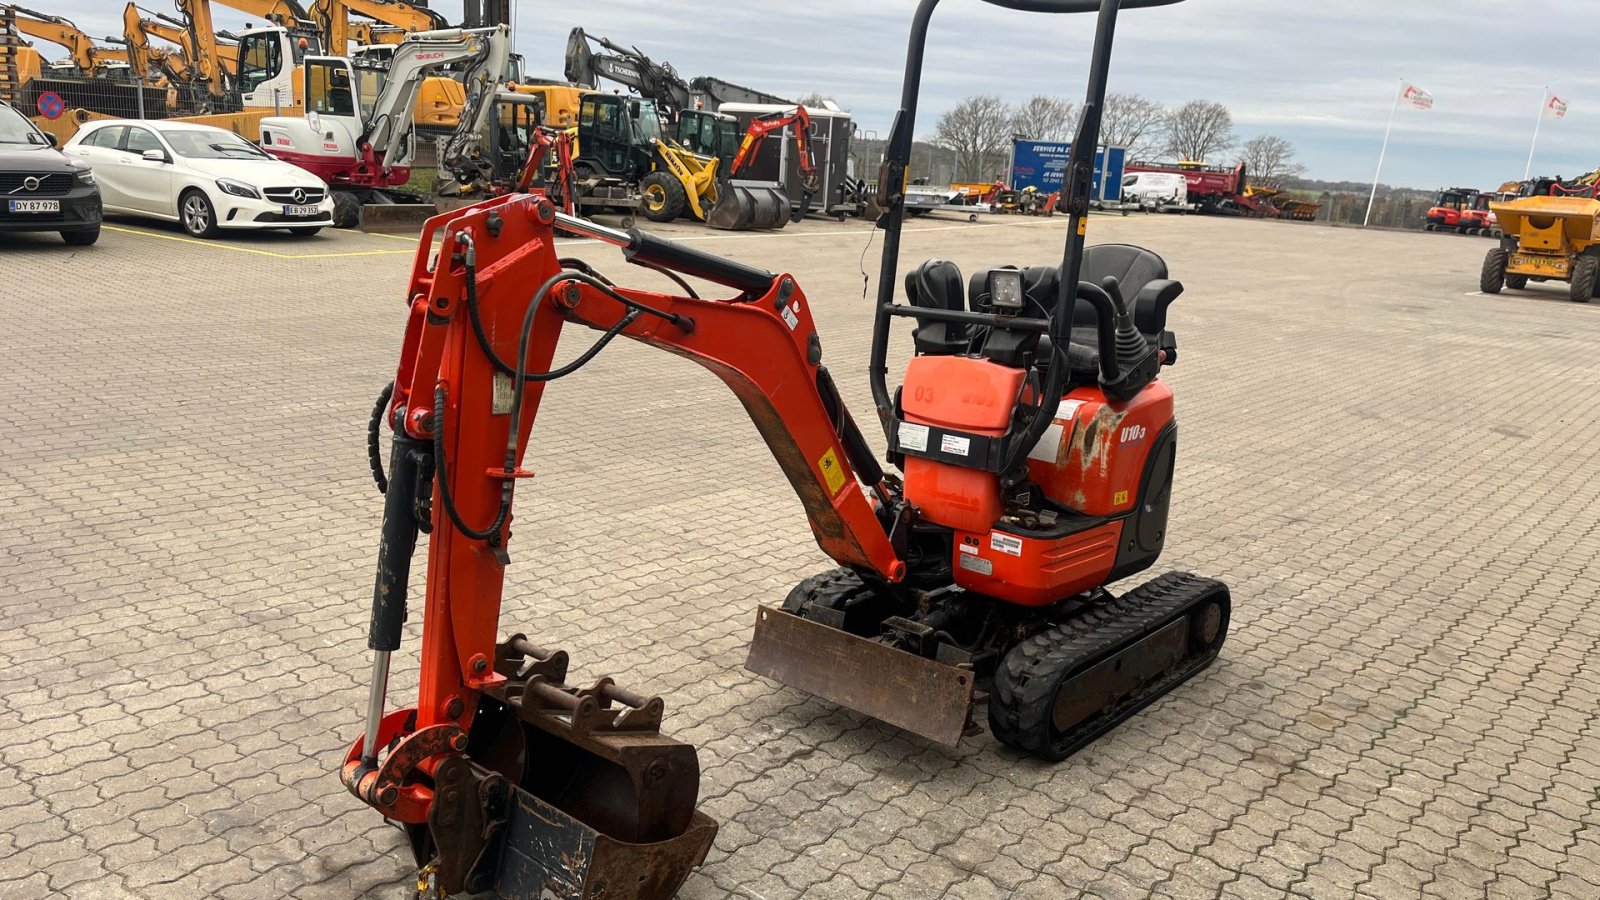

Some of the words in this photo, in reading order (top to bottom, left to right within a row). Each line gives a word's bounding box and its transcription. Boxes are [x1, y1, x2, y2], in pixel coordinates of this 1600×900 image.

[1033, 145, 1056, 153] SERVICE
[665, 151, 684, 176] KOMATSU
[16, 202, 28, 210] DY
[30, 202, 40, 210] 87
[42, 202, 59, 210] 978
[1120, 424, 1146, 443] U10-3
